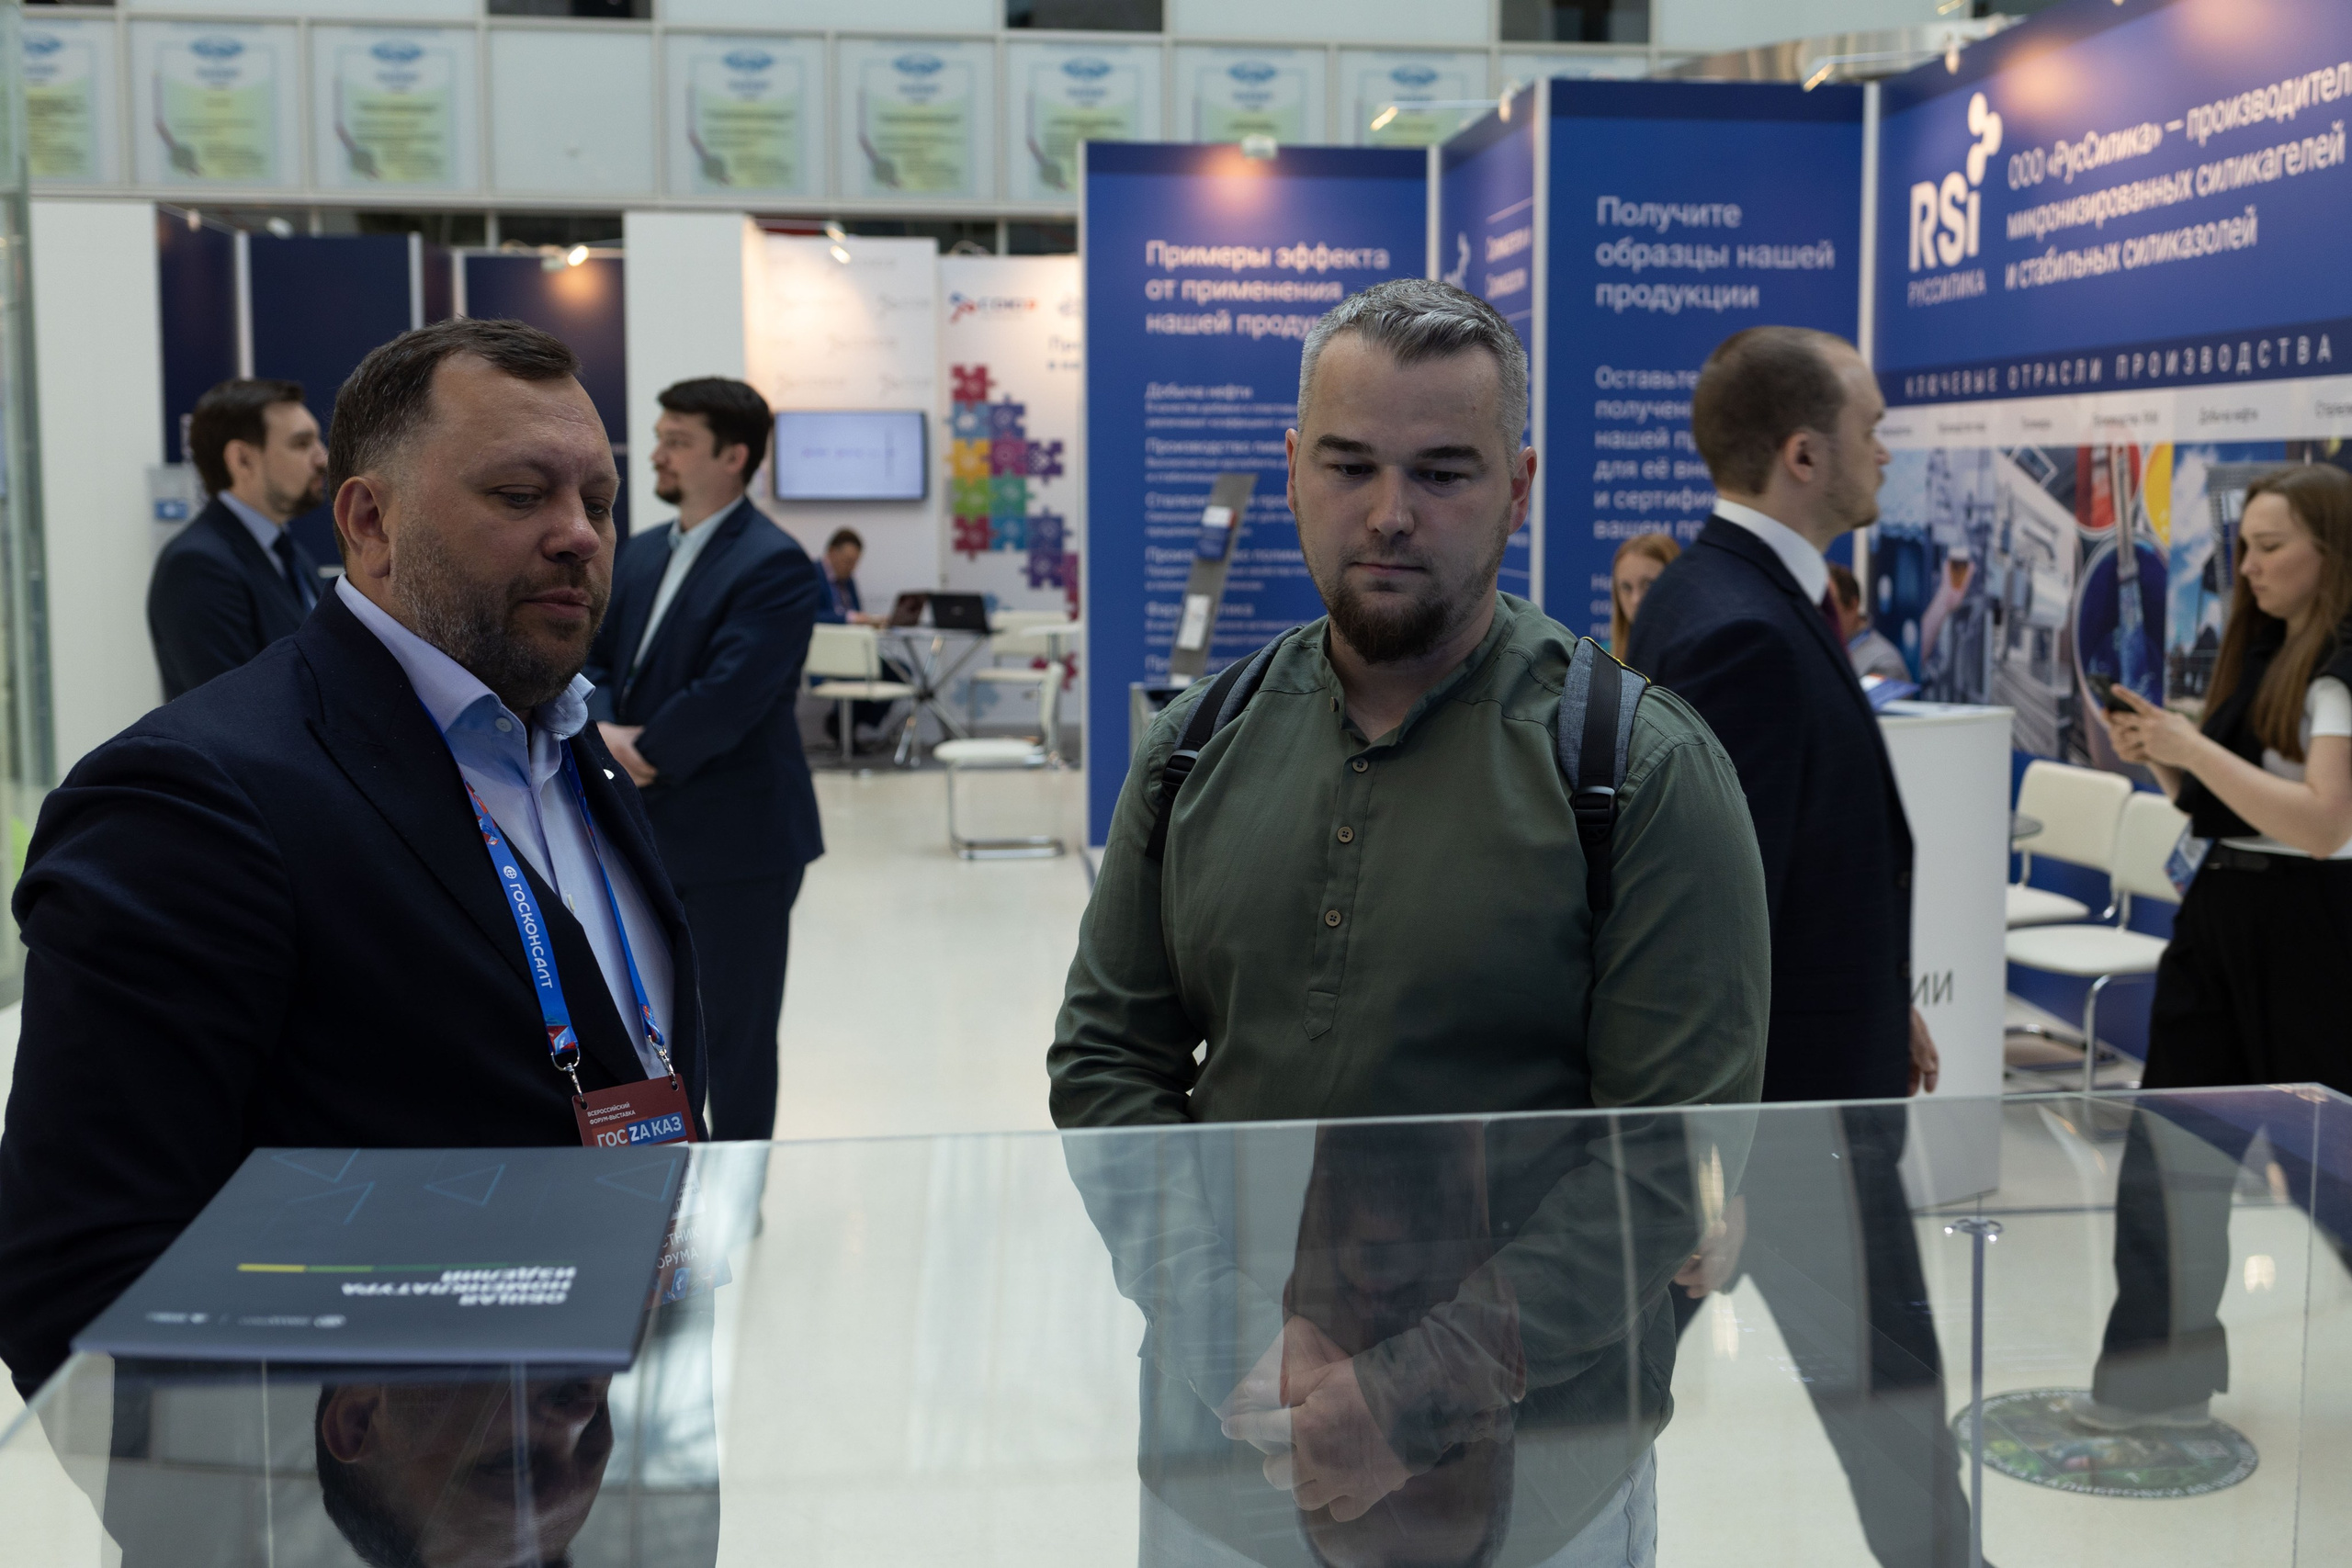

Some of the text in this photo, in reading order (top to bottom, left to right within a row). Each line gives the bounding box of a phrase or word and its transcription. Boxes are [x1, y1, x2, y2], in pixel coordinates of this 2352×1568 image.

[2007, 148, 2045, 190] ООО
[2046, 121, 2164, 183] «РусСилика»
[2006, 119, 2346, 243] микронизированных силикагелей
[1597, 196, 1742, 233] Получите
[1145, 239, 1390, 274] Примеры эффекта
[1596, 236, 1836, 273] образцы нашей
[2005, 204, 2258, 292] и стабильных силиказолей
[1146, 279, 1343, 306] от применения
[1595, 283, 1759, 314] продукции
[1146, 309, 1232, 334] нашей
[1905, 333, 2332, 398] КЛЮЧЕВЫЕ ОТРАСЛИ ПРОИЗВОДСТВА
[1594, 426, 1671, 450] нашей
[509, 883, 553, 989] ГОСКОНСАЛТ
[587, 1101, 631, 1117] ВСЕРОССИЙСКИЙ
[589, 1110, 637, 1125] ФОРУМ-ВЫСТАВКА
